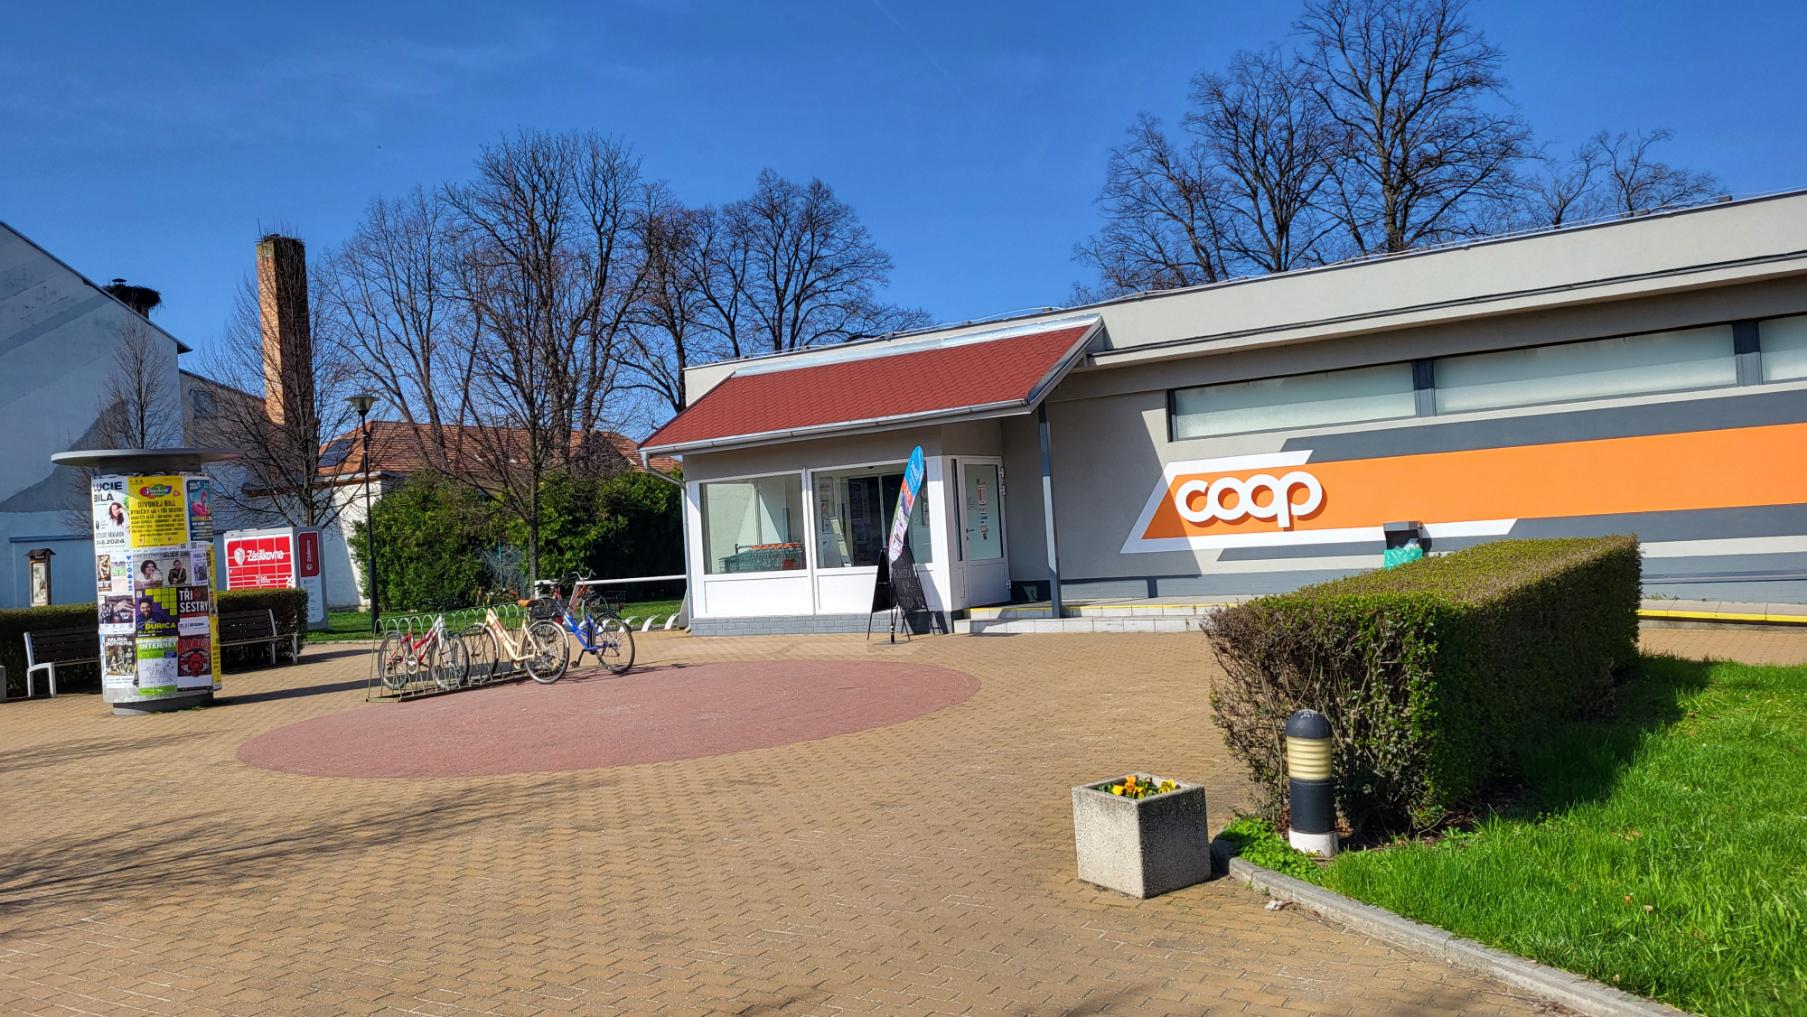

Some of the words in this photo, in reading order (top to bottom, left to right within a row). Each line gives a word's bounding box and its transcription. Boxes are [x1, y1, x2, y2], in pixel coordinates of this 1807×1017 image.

[93, 481, 123, 491] LUCIE
[1175, 471, 1323, 528] coop
[180, 588, 193, 602] TŘI
[180, 601, 209, 613] SESTRY
[139, 641, 177, 650] INTERNET
